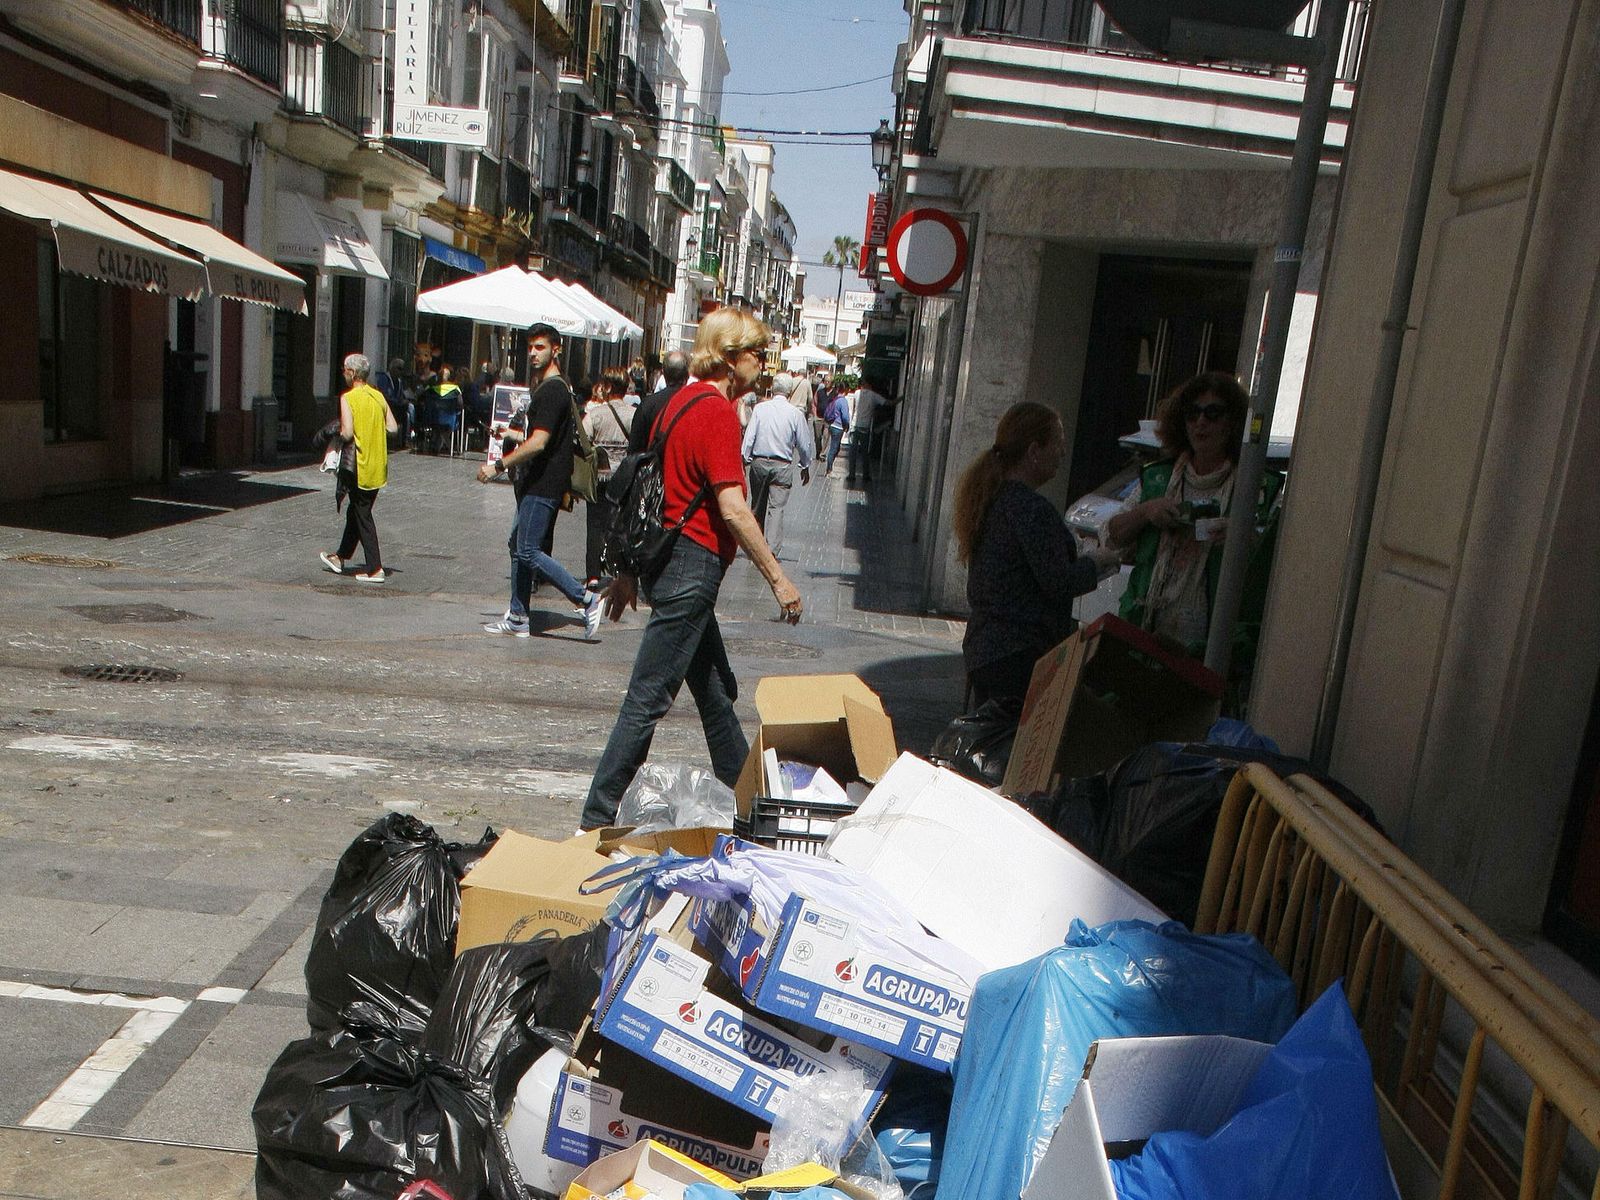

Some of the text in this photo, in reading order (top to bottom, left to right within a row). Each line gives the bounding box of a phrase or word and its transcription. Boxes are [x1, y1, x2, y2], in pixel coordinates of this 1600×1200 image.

[405, 109, 459, 125] JIMENEZ
[396, 120, 423, 135] RUIZ
[97, 247, 169, 290] CALZADOS
[234, 273, 280, 303] EL POLLO
[541, 314, 576, 327] Cruzcampo
[538, 909, 583, 928] PANADERIA
